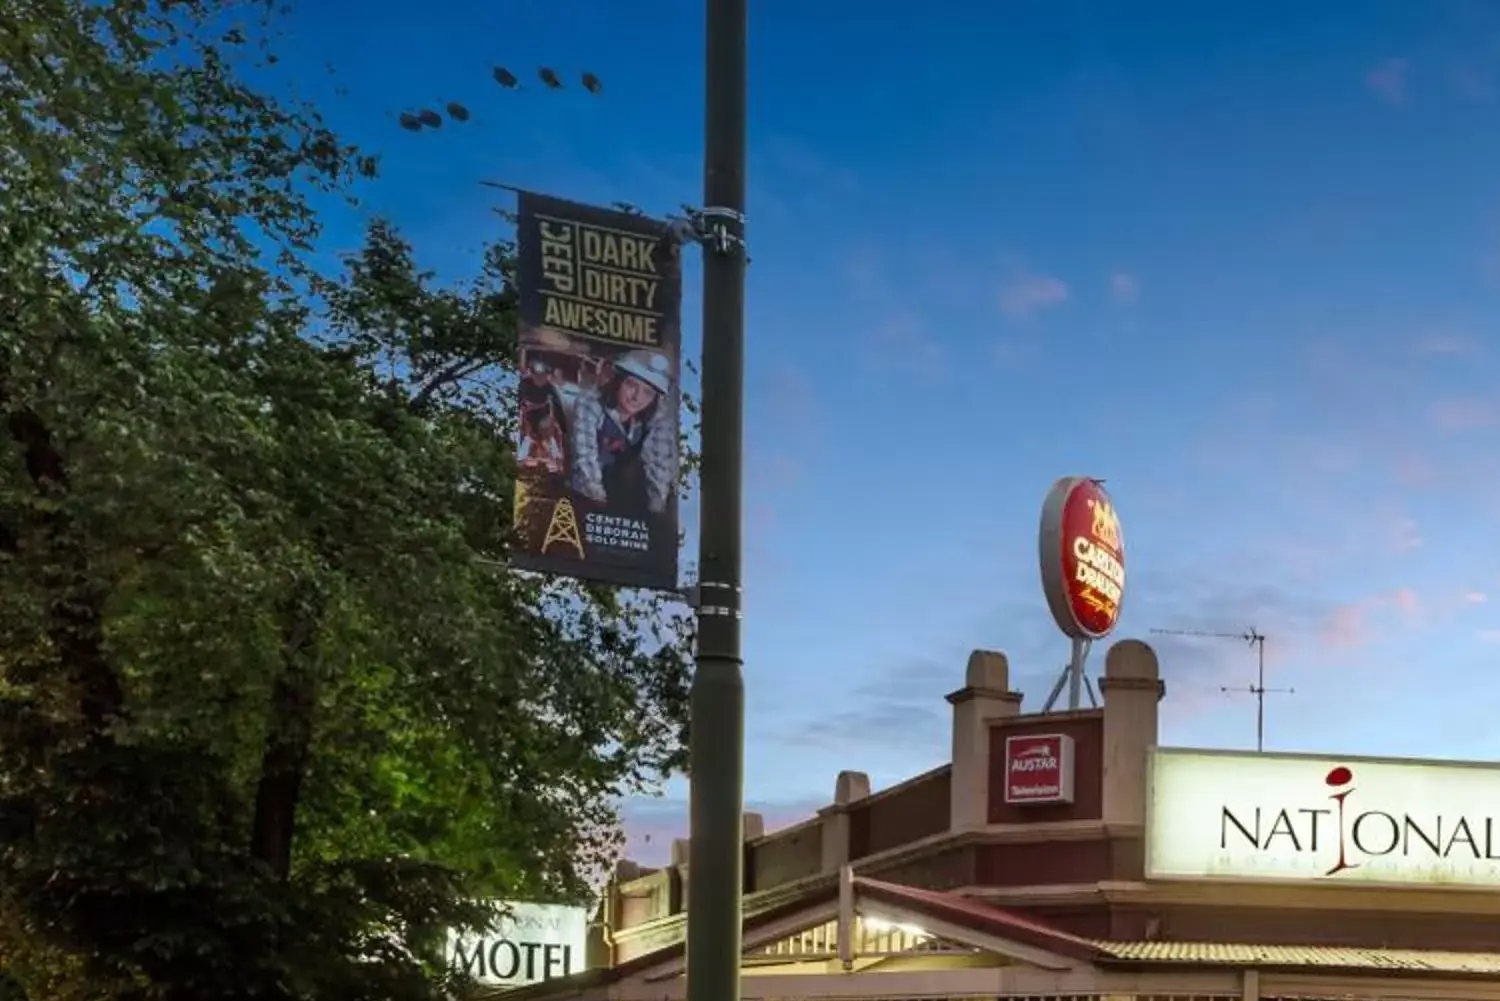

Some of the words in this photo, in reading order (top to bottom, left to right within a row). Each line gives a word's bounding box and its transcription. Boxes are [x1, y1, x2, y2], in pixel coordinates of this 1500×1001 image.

[583, 230, 656, 273] DARK
[584, 269, 657, 309] DIRTY
[545, 297, 657, 343] AWESOME
[585, 522, 649, 541] DEBORAH
[586, 512, 649, 531] CENTRAL
[1011, 756, 1058, 773] AUSTAR
